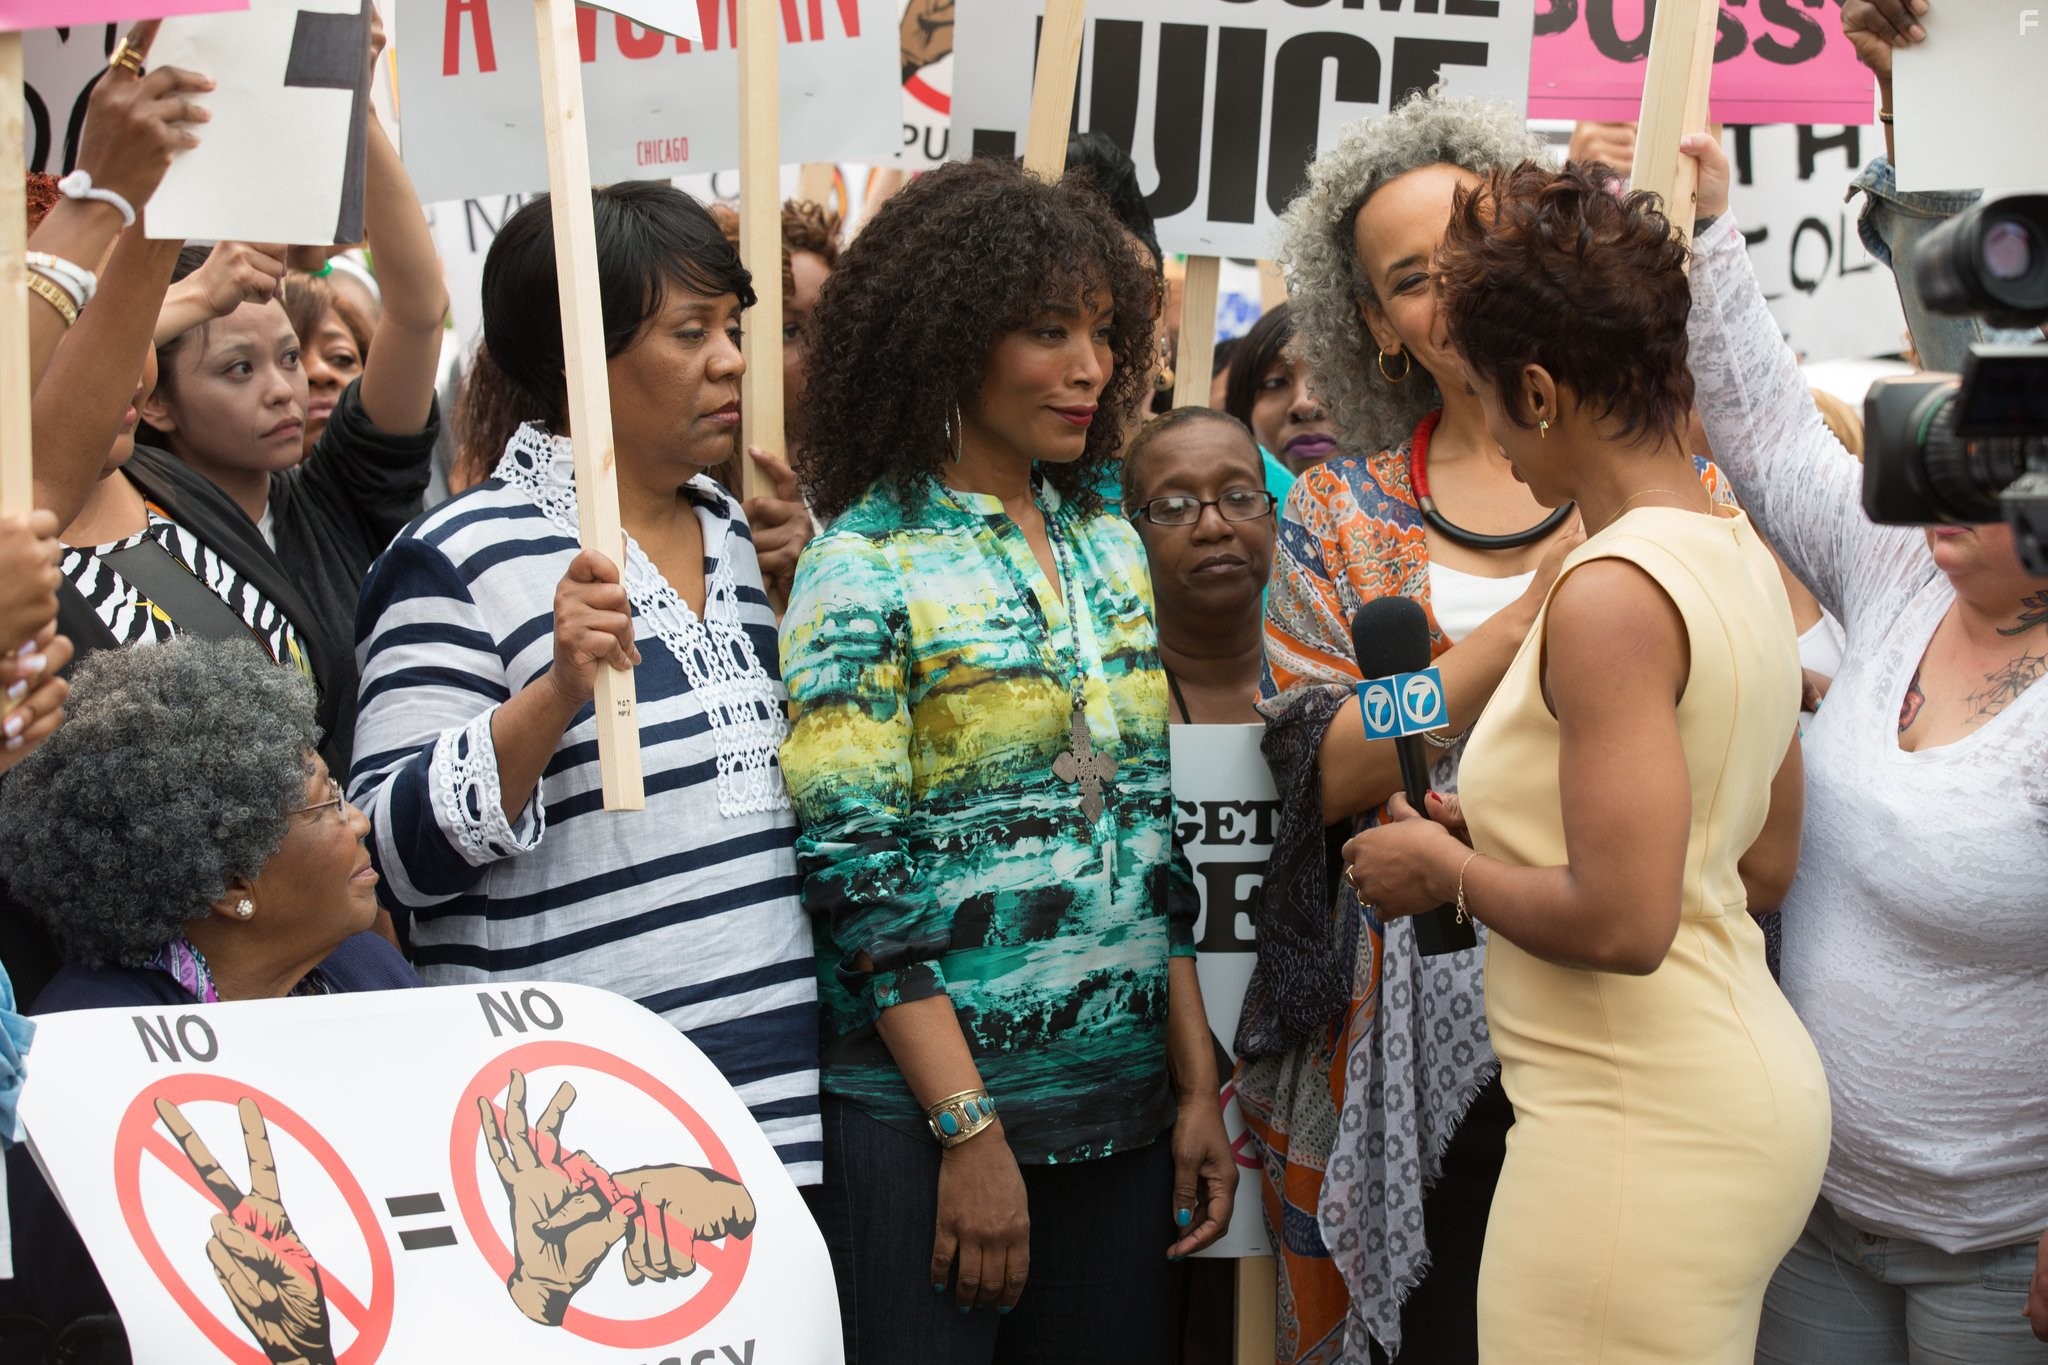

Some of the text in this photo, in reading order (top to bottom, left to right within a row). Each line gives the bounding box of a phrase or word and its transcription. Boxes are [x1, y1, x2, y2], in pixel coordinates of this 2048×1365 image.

[636, 136, 689, 166] CHICAGO
[1366, 690, 1391, 730] 7
[1406, 680, 1438, 720] 7
[477, 988, 564, 1038] NO
[131, 1014, 219, 1063] NO
